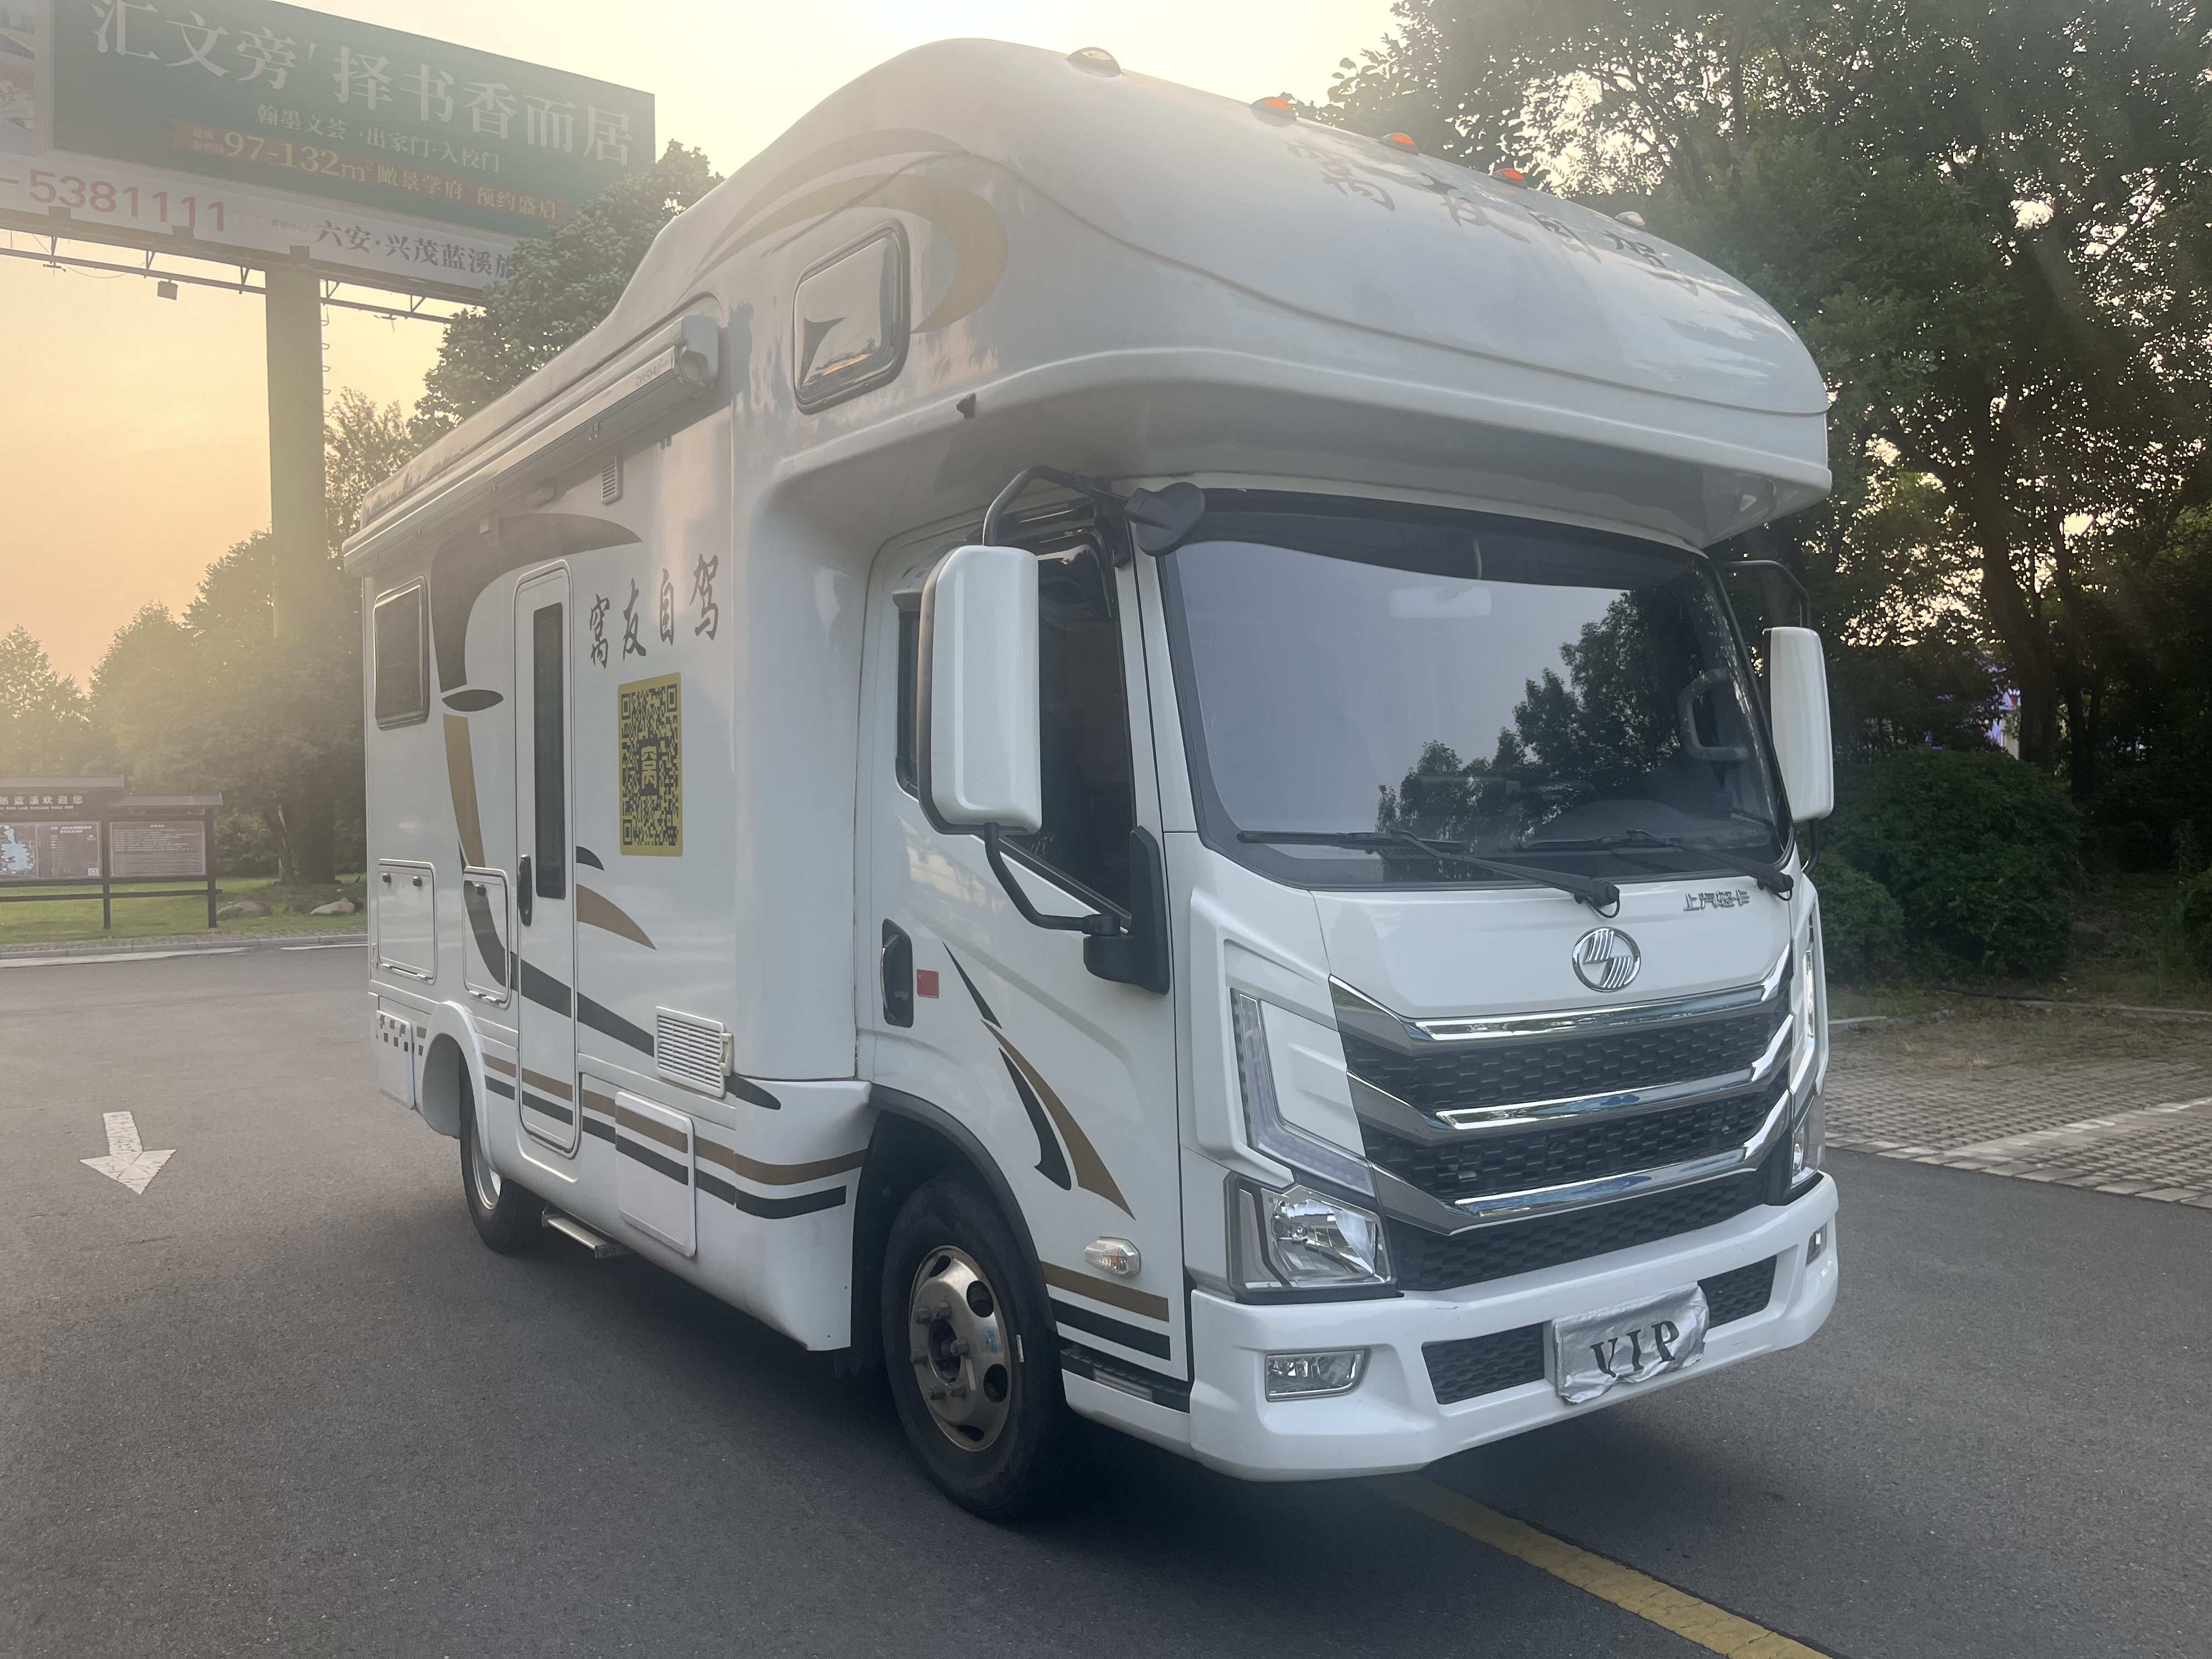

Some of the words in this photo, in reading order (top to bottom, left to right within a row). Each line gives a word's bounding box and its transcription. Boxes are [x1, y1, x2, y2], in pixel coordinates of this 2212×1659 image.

[590, 553, 720, 669] 窝友自驾
[1589, 1320, 1680, 1379] VIP
